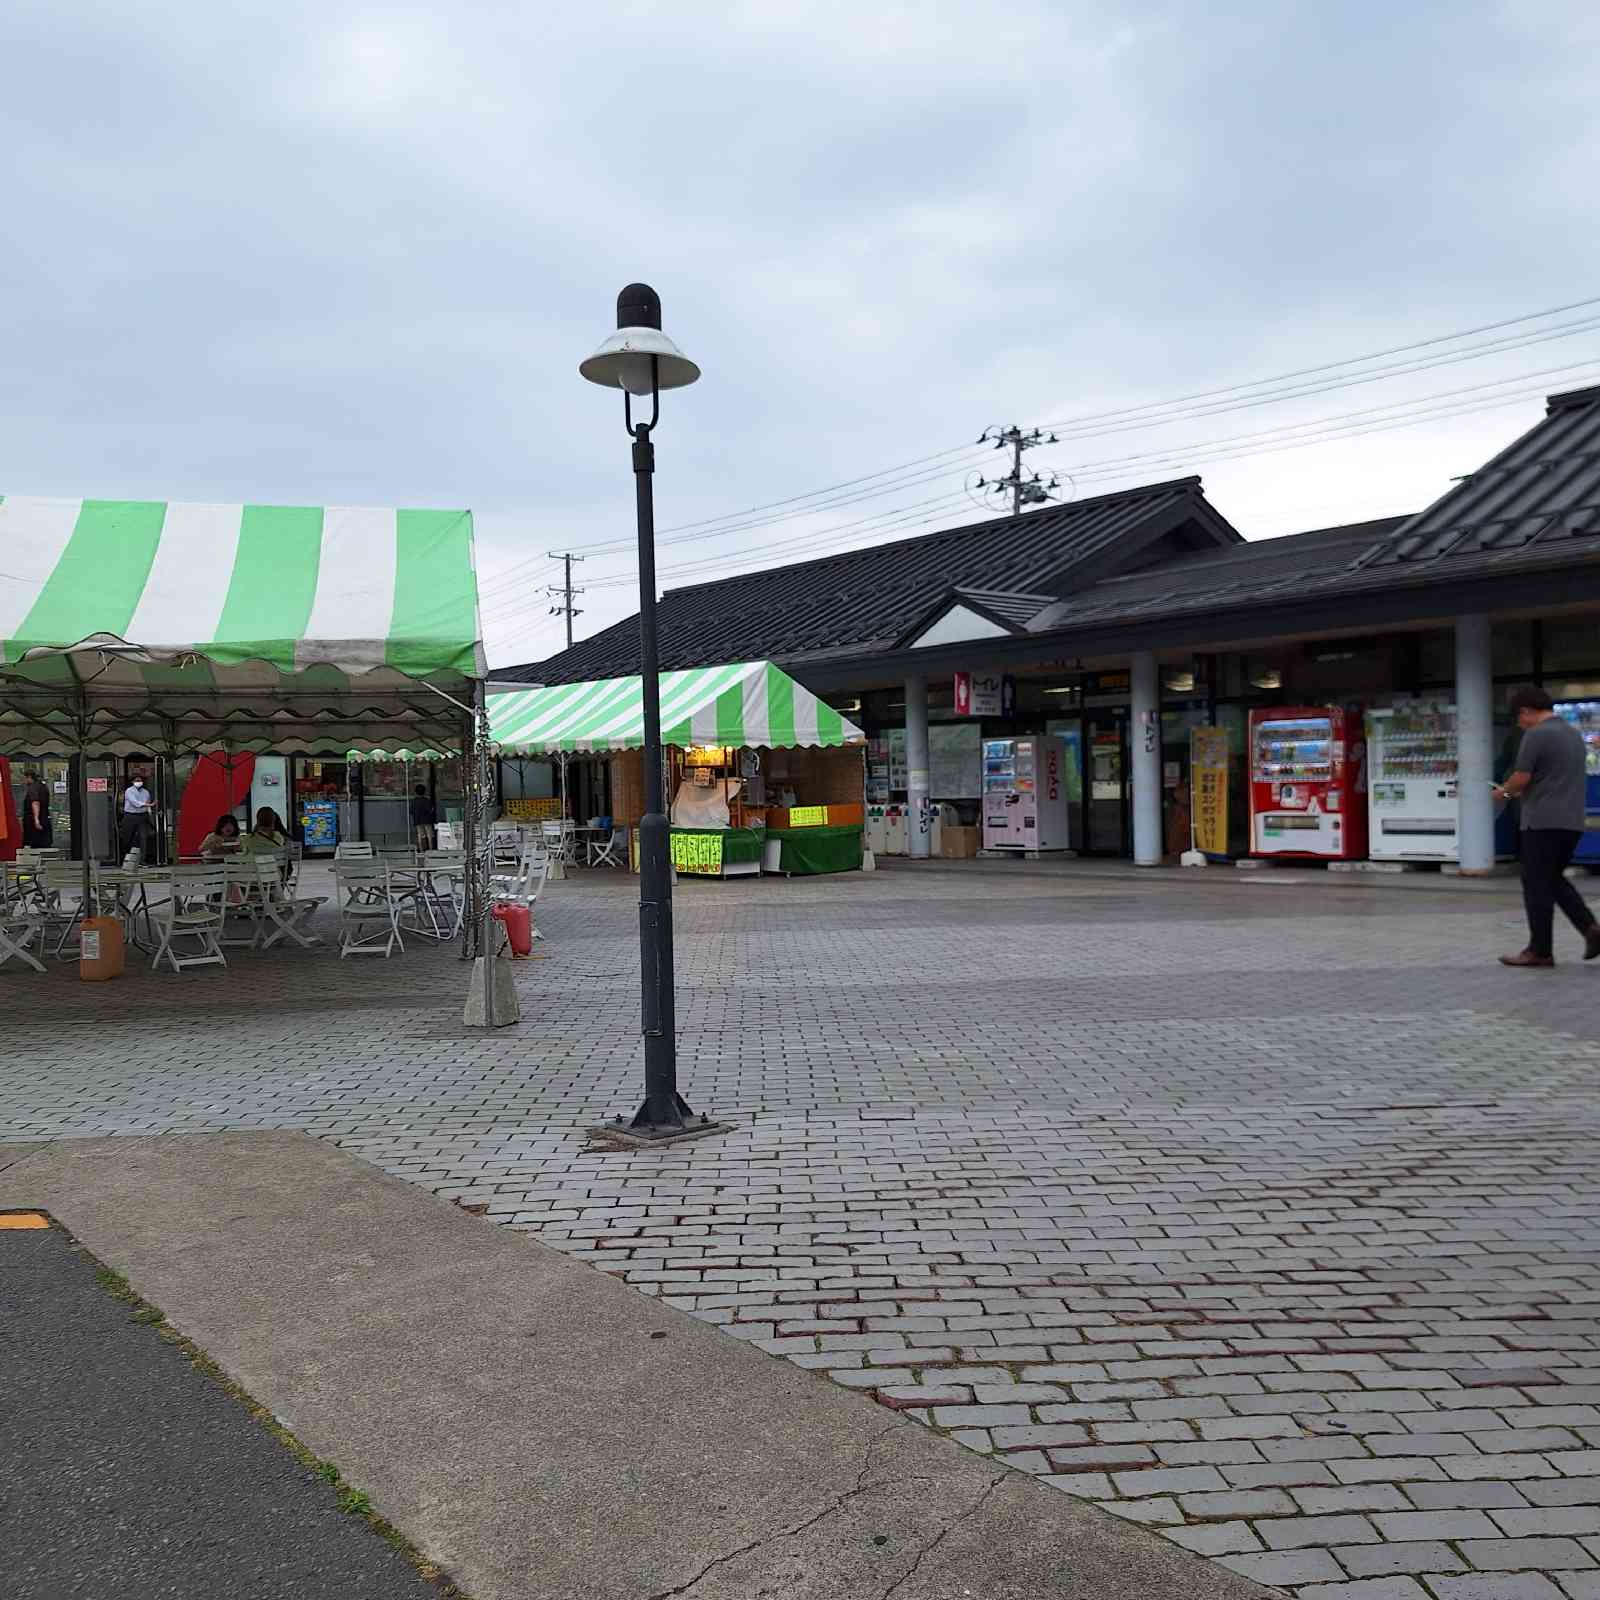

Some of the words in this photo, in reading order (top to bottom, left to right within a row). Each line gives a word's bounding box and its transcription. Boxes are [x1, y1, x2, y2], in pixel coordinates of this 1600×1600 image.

[972, 676, 1000, 691] トイレ
[919, 808, 929, 834] トイレ
